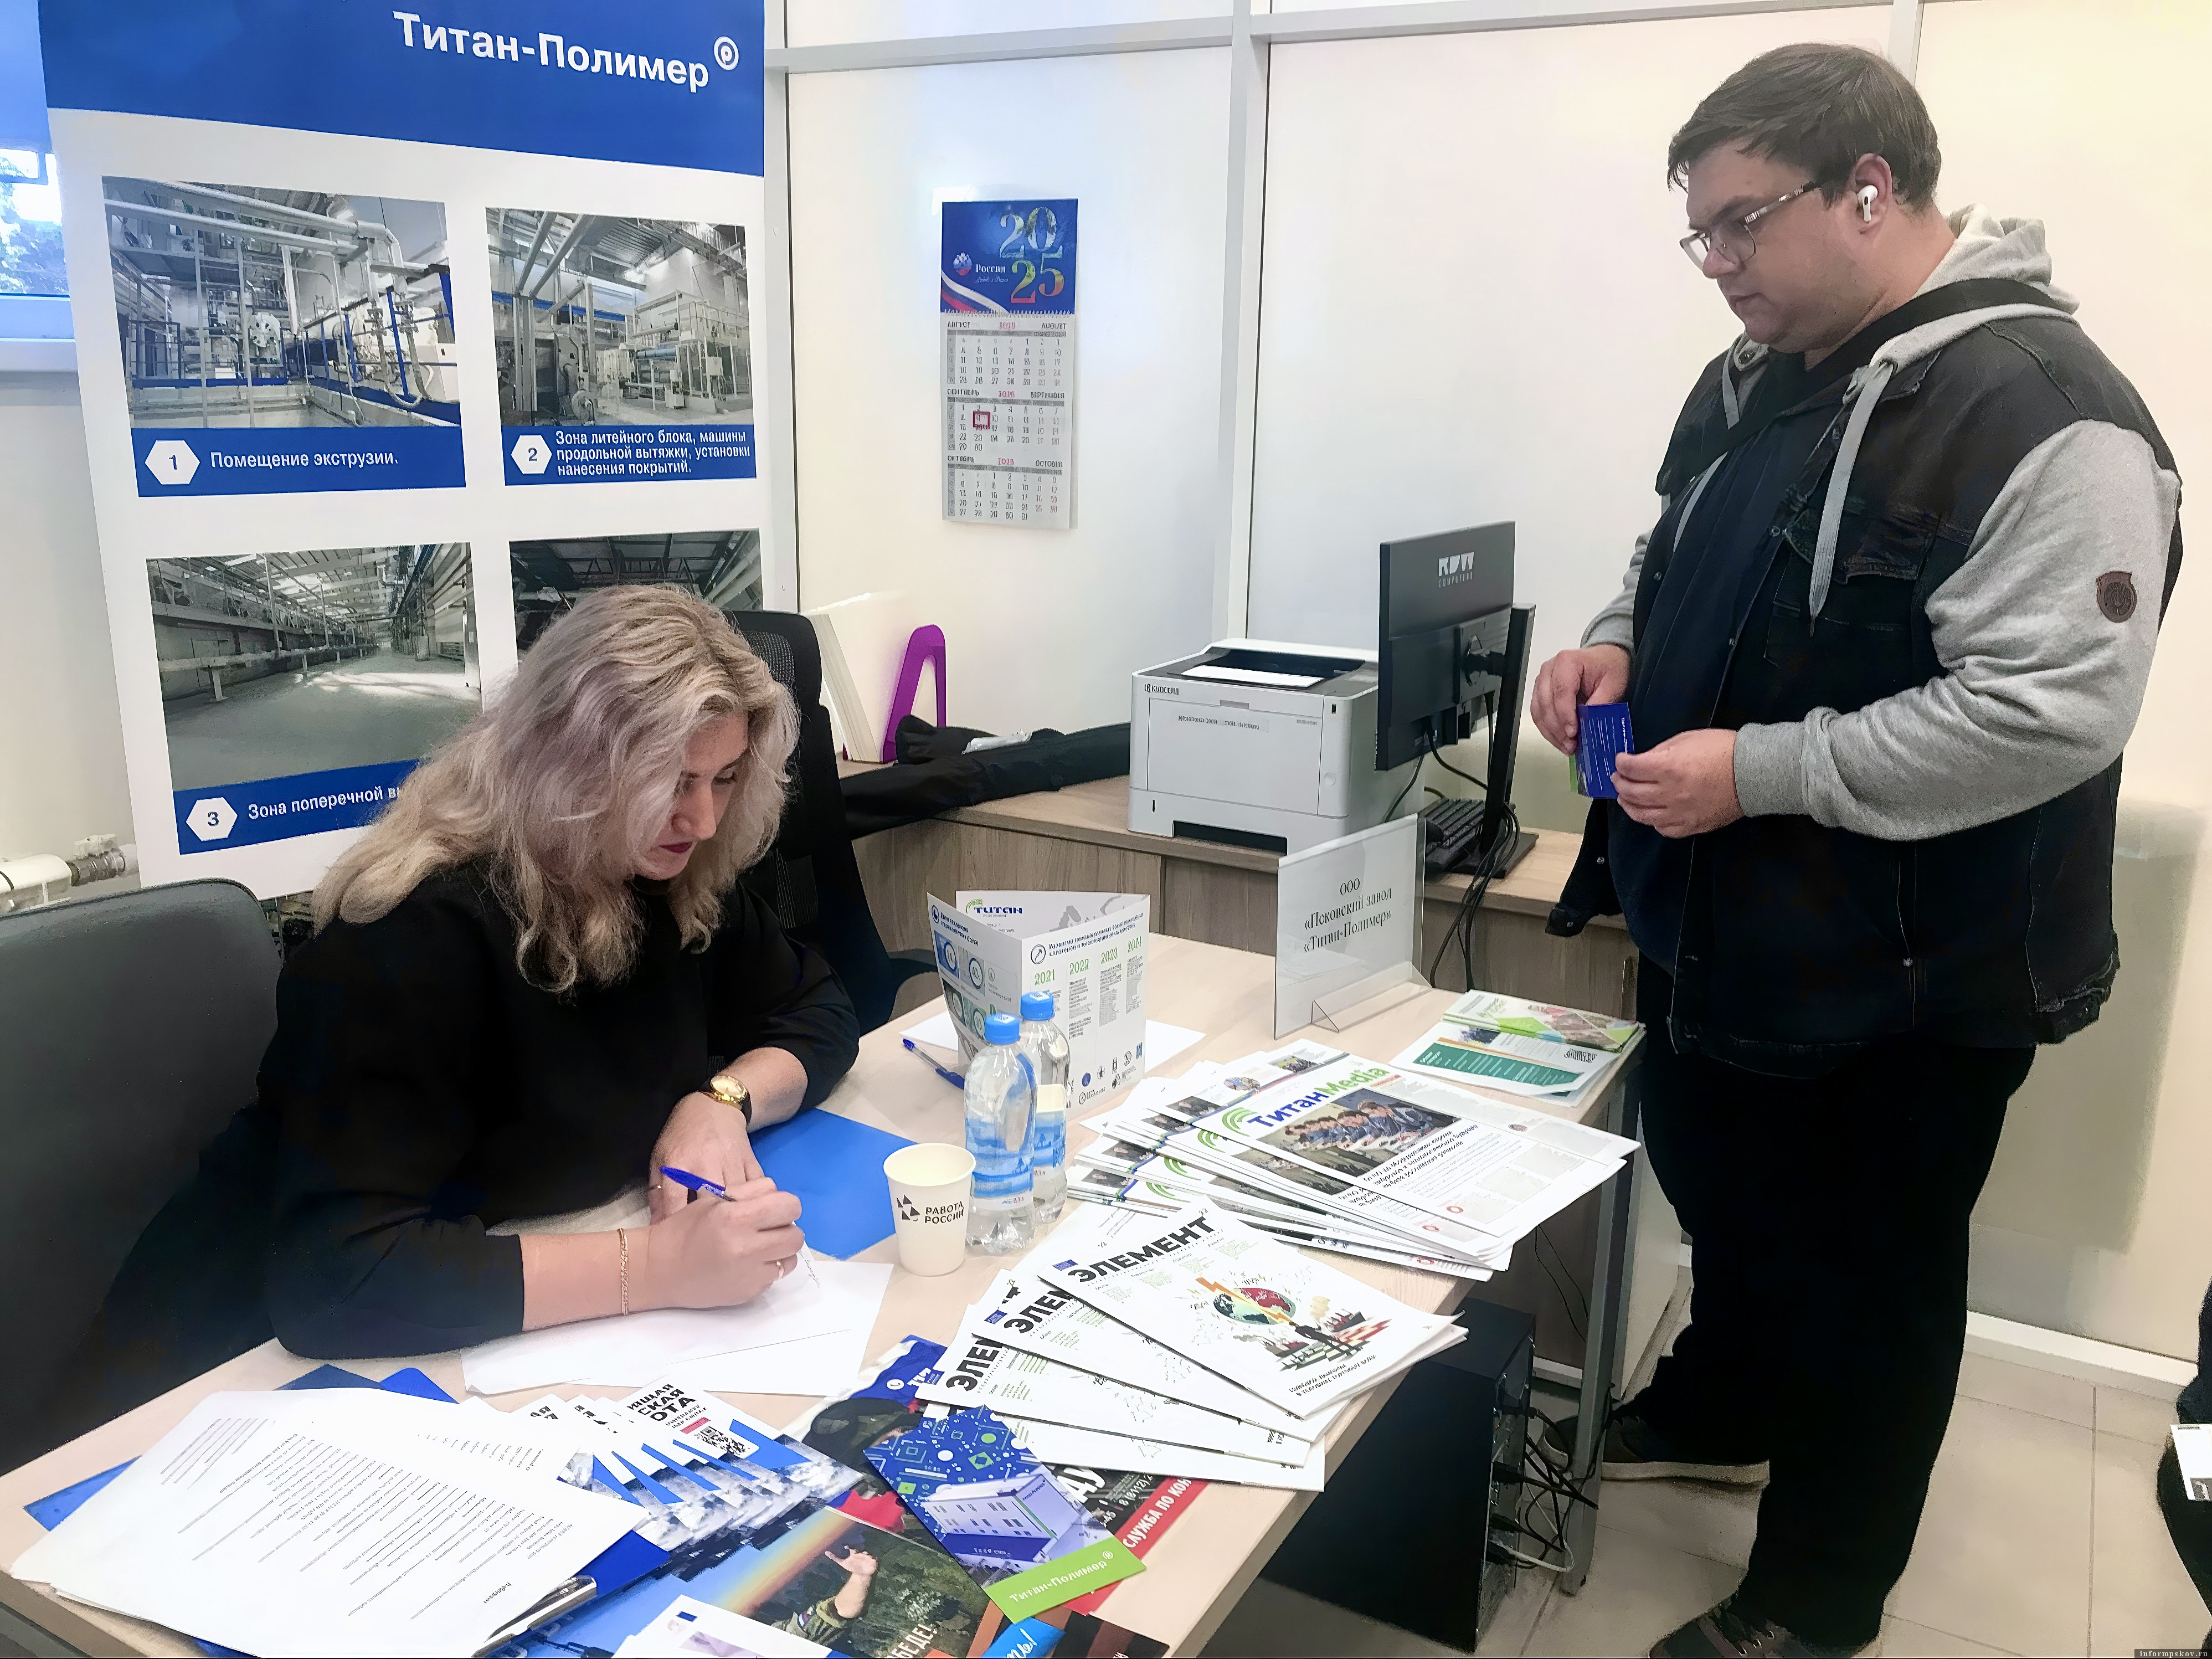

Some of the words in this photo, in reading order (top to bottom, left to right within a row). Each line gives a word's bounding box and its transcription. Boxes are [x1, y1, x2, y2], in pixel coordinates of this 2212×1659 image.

[393, 11, 709, 93] Титан-Полимер
[999, 207, 1057, 258] 20
[1010, 245, 1064, 304] 25
[555, 430, 588, 445] Зона
[591, 430, 655, 444] литейного
[658, 428, 696, 444] блока,
[699, 431, 746, 443] машины
[168, 455, 178, 470] 1
[210, 451, 309, 469] Помещение
[313, 451, 399, 469] экструзии.
[528, 448, 538, 461] 2
[557, 445, 632, 462] продольной
[636, 446, 691, 459] вытяжки,
[695, 445, 750, 459] установки
[558, 461, 625, 476] нанесения
[629, 459, 691, 477] покрытий.
[1438, 552, 1475, 577] RDW
[248, 802, 287, 820] Зона
[292, 785, 383, 813] поперечной
[207, 811, 219, 826] 3
[1340, 878, 1360, 896] ООО
[925, 1201, 964, 1215] РАБОТА
[1067, 1216, 1216, 1283] ЭЛЕМЕНТ
[1122, 1508, 1164, 1549] СЛУЖБА
[1156, 1496, 1175, 1511] ПО
[887, 1624, 938, 1658] БЕДЕ!
